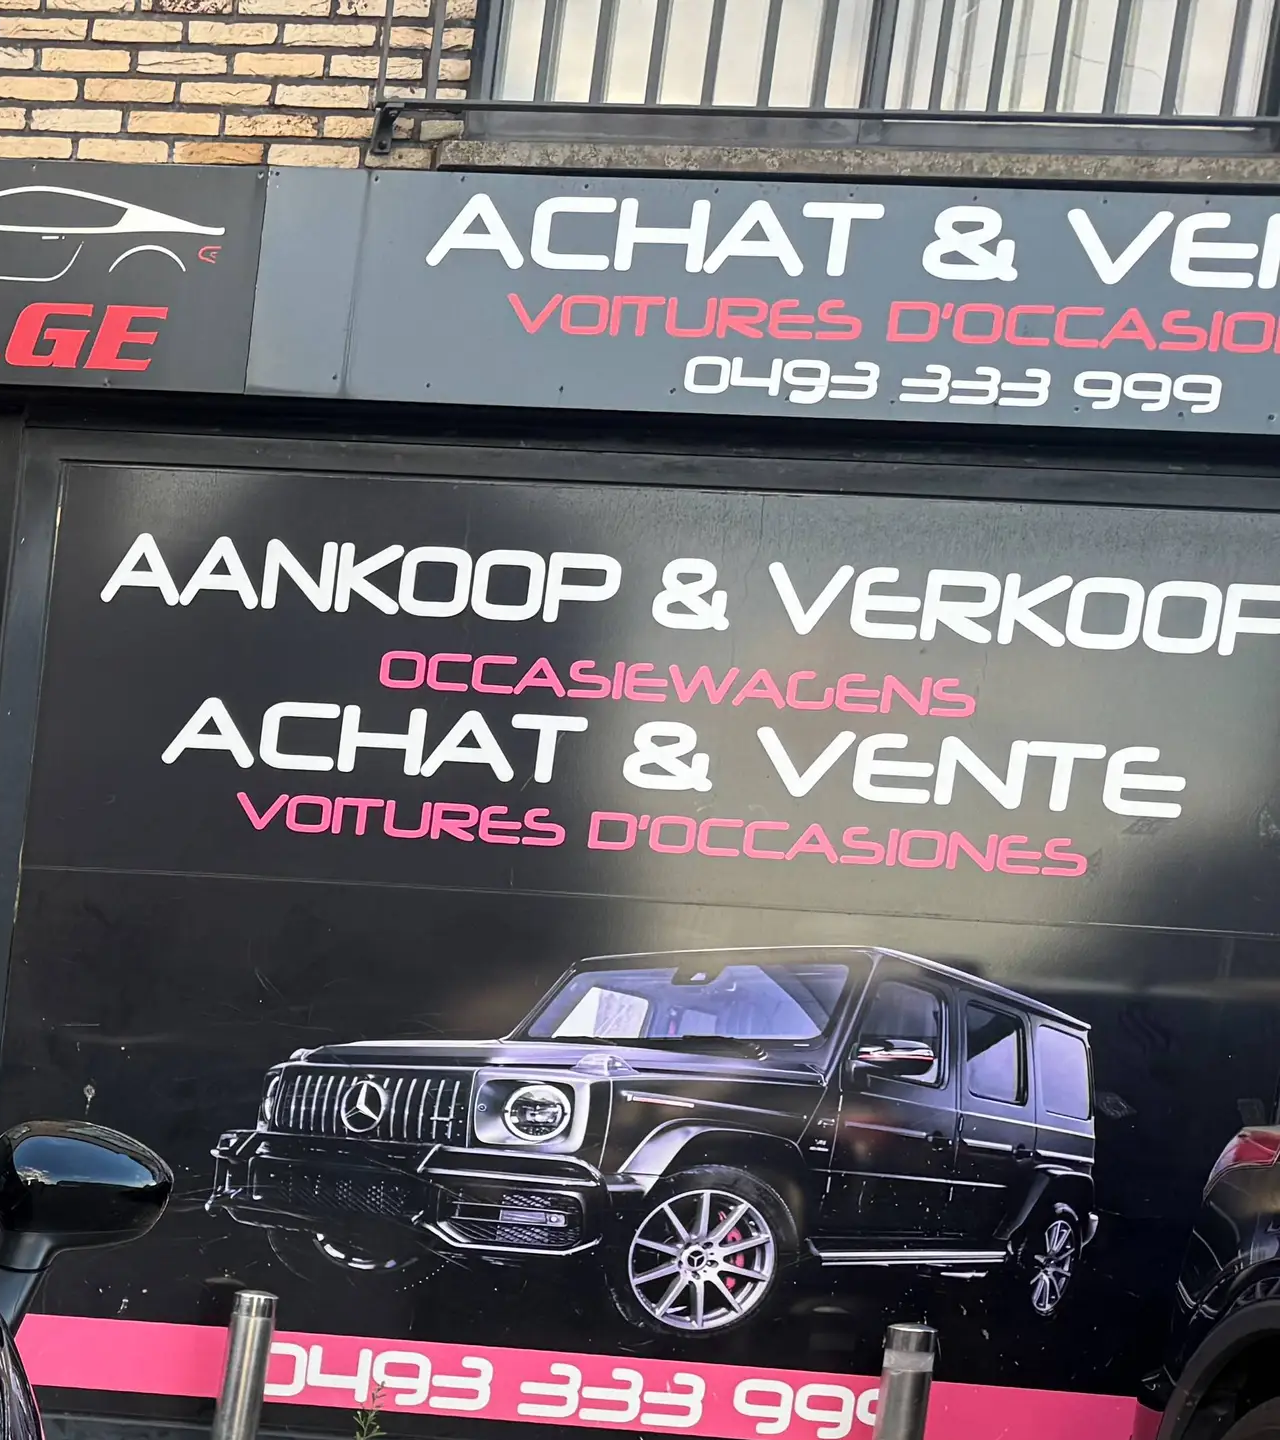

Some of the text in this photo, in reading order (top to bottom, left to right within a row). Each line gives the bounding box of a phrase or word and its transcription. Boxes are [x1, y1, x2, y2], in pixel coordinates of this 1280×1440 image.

[425, 192, 886, 278] ACHAT
[921, 205, 1019, 282] &
[508, 294, 1280, 354] VOITURES D'OCCASIO
[683, 355, 1223, 414] 0493 333 999
[100, 532, 1280, 657] AANKOOP & VERKOOP
[379, 651, 975, 718] OCCASIEWAGENS
[161, 697, 1187, 819] ACHAT & VENTE
[237, 792, 1087, 876] VOITURES D'OCCASIONES
[263, 1342, 494, 1411] 0493
[517, 1362, 706, 1428] 333
